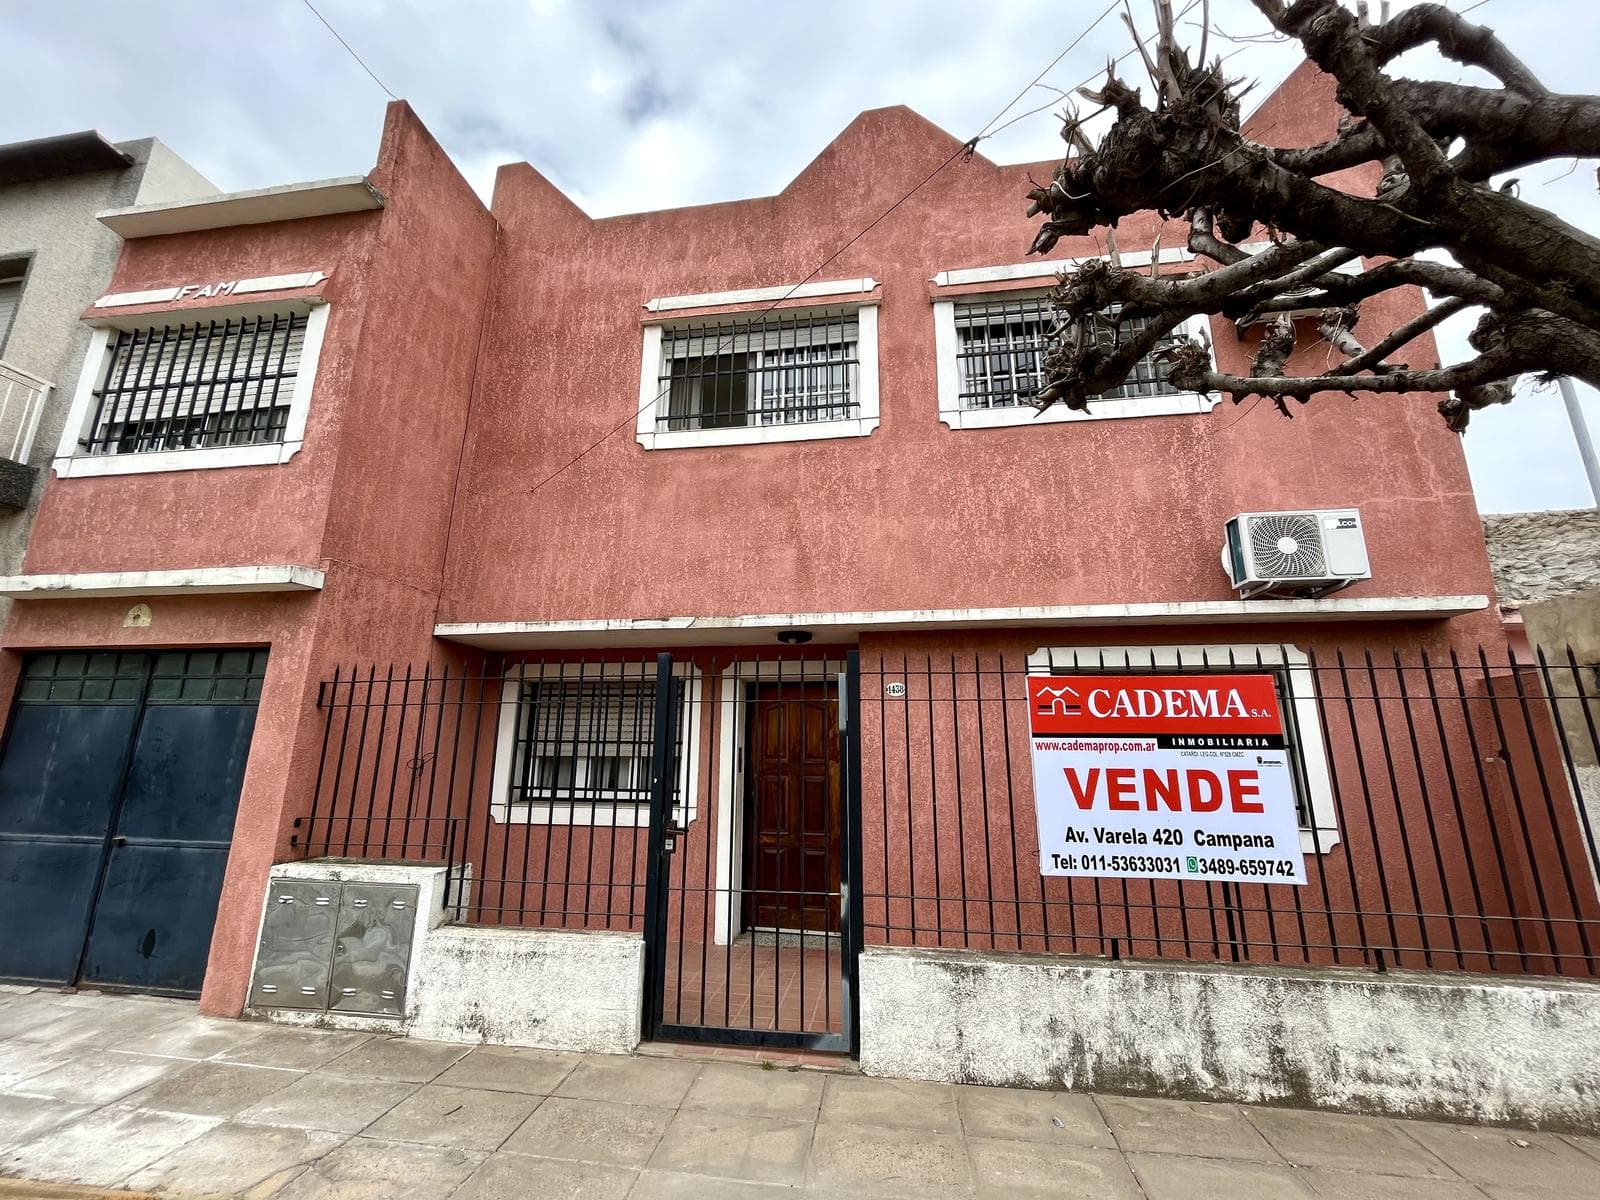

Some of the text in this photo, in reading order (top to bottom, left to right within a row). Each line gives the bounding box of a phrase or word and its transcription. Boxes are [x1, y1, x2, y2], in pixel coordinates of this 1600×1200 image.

[176, 281, 238, 301] FAM
[888, 685, 905, 694] 1438
[1087, 688, 1272, 718] CADEMA S.A.
[1034, 739, 1156, 754] www.cademaprop.com.ar
[1172, 737, 1269, 747] INMOBILIARIA
[1064, 768, 1265, 814] VENDE
[1065, 826, 1275, 851] Av. Varela 420 Campana
[1051, 853, 1295, 877] Tel: 011-53633031 3489-659742
